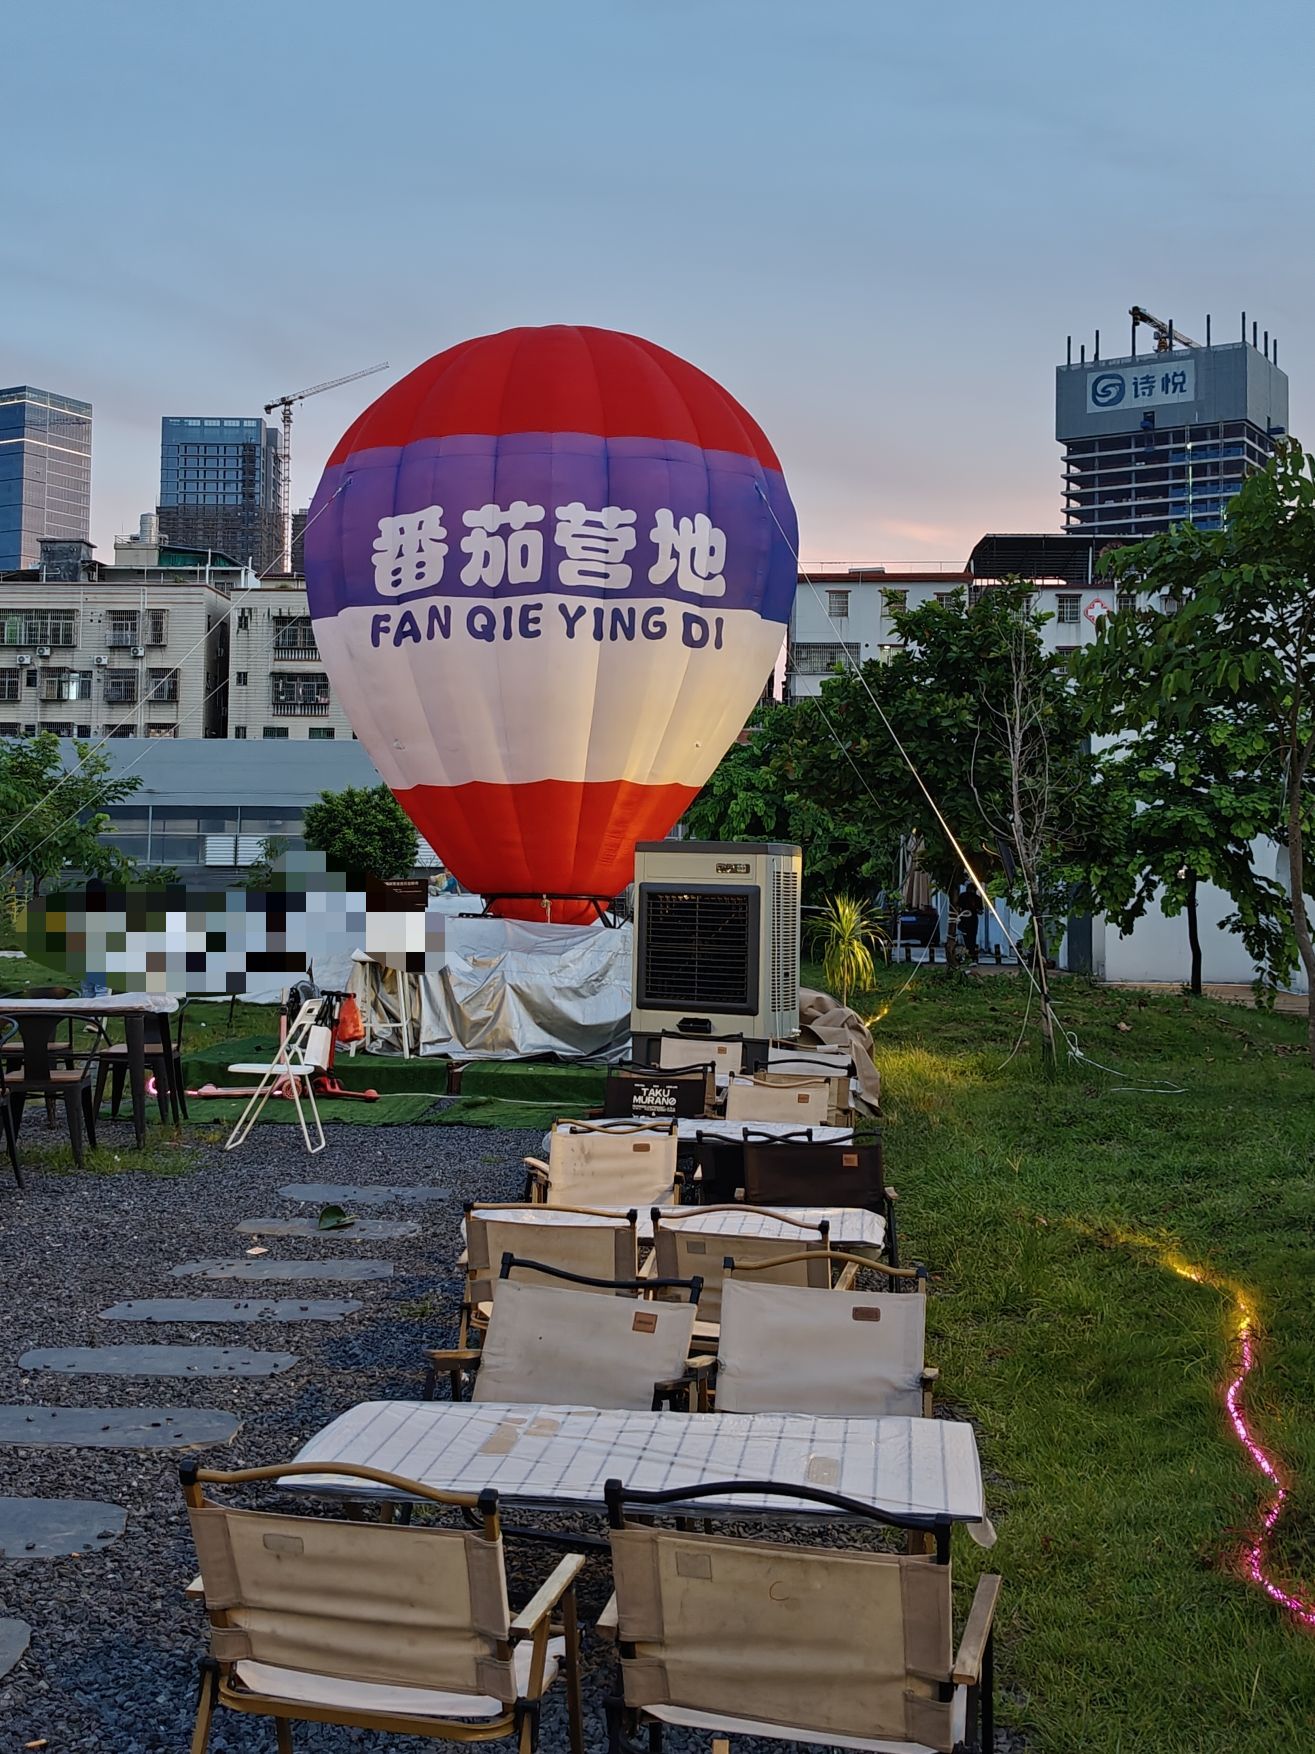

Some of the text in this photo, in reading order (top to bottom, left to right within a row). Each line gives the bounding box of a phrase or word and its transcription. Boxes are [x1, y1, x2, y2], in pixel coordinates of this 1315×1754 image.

[1132, 370, 1187, 399] 诗悦
[371, 500, 727, 597] 番茄营地
[371, 602, 724, 650] FAN QIE YING DI
[641, 1087, 671, 1098] TAKU
